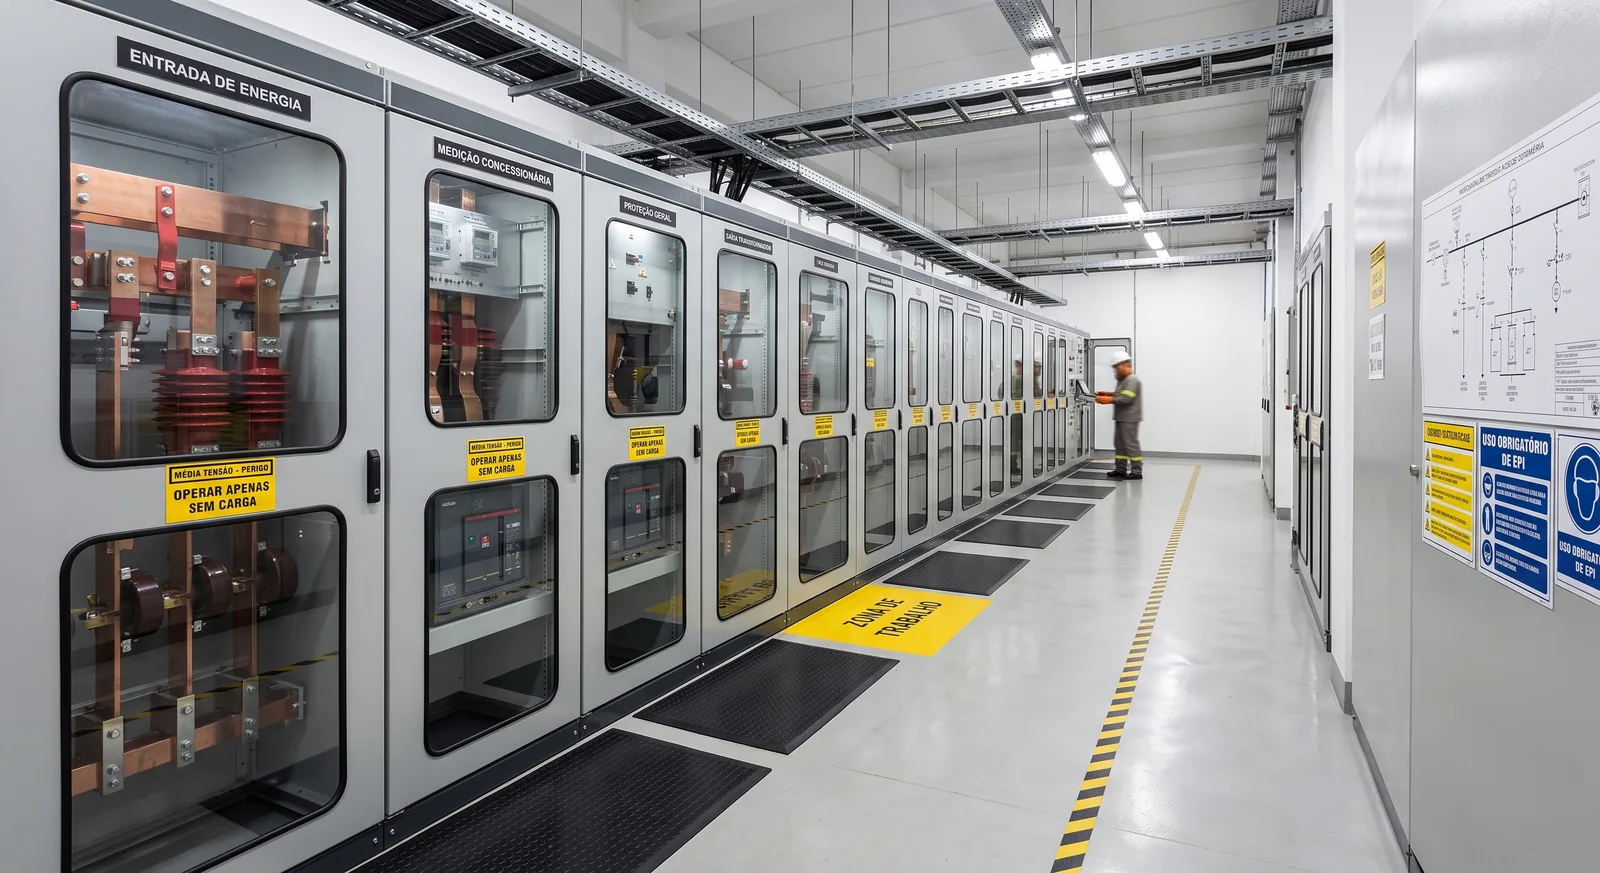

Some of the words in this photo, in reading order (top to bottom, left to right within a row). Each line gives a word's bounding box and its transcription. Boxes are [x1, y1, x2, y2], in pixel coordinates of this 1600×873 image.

[129, 48, 211, 85] ENTRADA
[214, 74, 236, 93] DE
[239, 82, 303, 112] ENERGIA
[437, 143, 480, 164] MEDIÇÃO
[481, 157, 552, 186] CONCESSIONÁRIA
[624, 201, 654, 216] PROTEÇÃO
[654, 210, 672, 222] GERAL
[1482, 433, 1496, 447] USO
[1497, 435, 1549, 456] OBRIGATÓRIO
[471, 455, 497, 466] OPERAR
[498, 453, 522, 463] APENAS
[1501, 453, 1512, 468] DE
[1512, 454, 1525, 470] EPI
[174, 467, 201, 479] MÉDIA
[203, 465, 233, 477] TENSÃO
[241, 464, 269, 474] PERIGO
[478, 466, 493, 476] SEM
[494, 464, 515, 475] CARGA
[173, 486, 222, 501] OPERAR
[226, 481, 270, 495] APENAS
[188, 501, 215, 513] SEM
[219, 496, 257, 510] CARGA
[1559, 540, 1571, 554] USO
[1572, 545, 1600, 565] OBRIGAT
[1575, 561, 1584, 574] DE
[1585, 564, 1596, 579] EPI
[842, 608, 891, 628] ZONA
[874, 598, 905, 608] DE
[874, 601, 942, 636] TRABALHO
